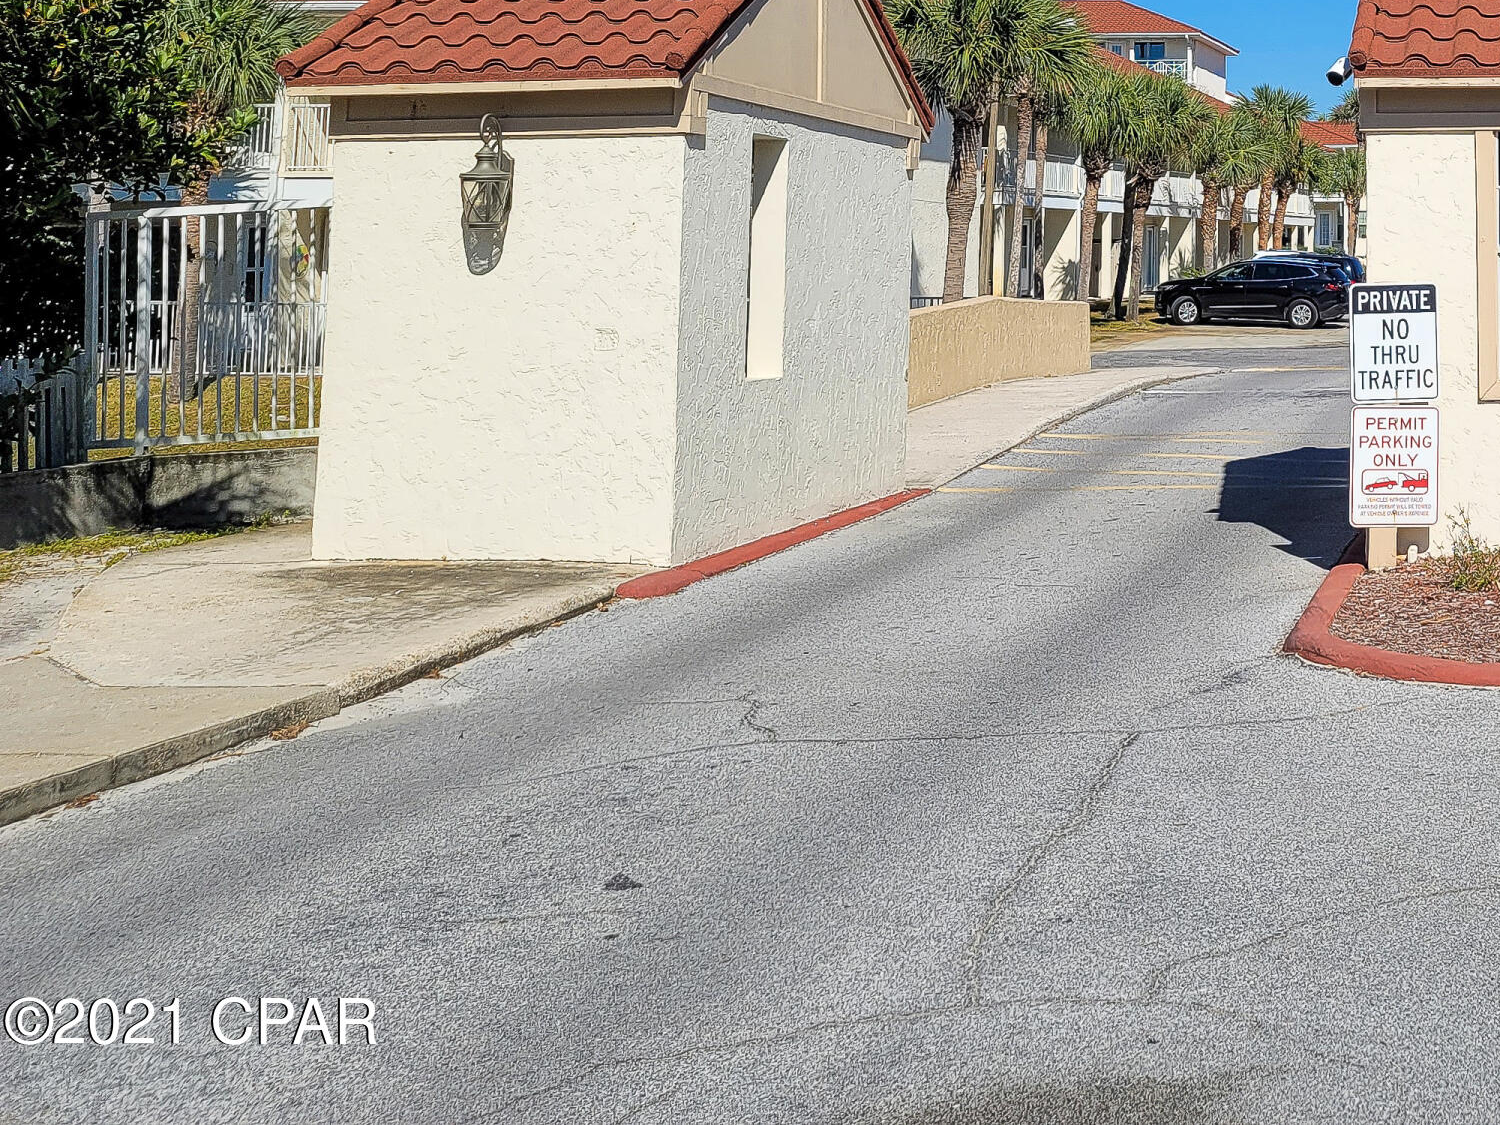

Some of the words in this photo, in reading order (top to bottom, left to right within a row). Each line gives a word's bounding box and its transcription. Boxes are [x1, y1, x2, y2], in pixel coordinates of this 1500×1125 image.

[1358, 290, 1431, 311] PRIVATE
[1382, 318, 1409, 340] NO
[1370, 344, 1419, 365] THRU
[1358, 369, 1434, 390] TRAFFIC
[1366, 417, 1427, 430] PERMIT
[1359, 435, 1432, 448] PARKING
[1373, 453, 1418, 467] ONLY
